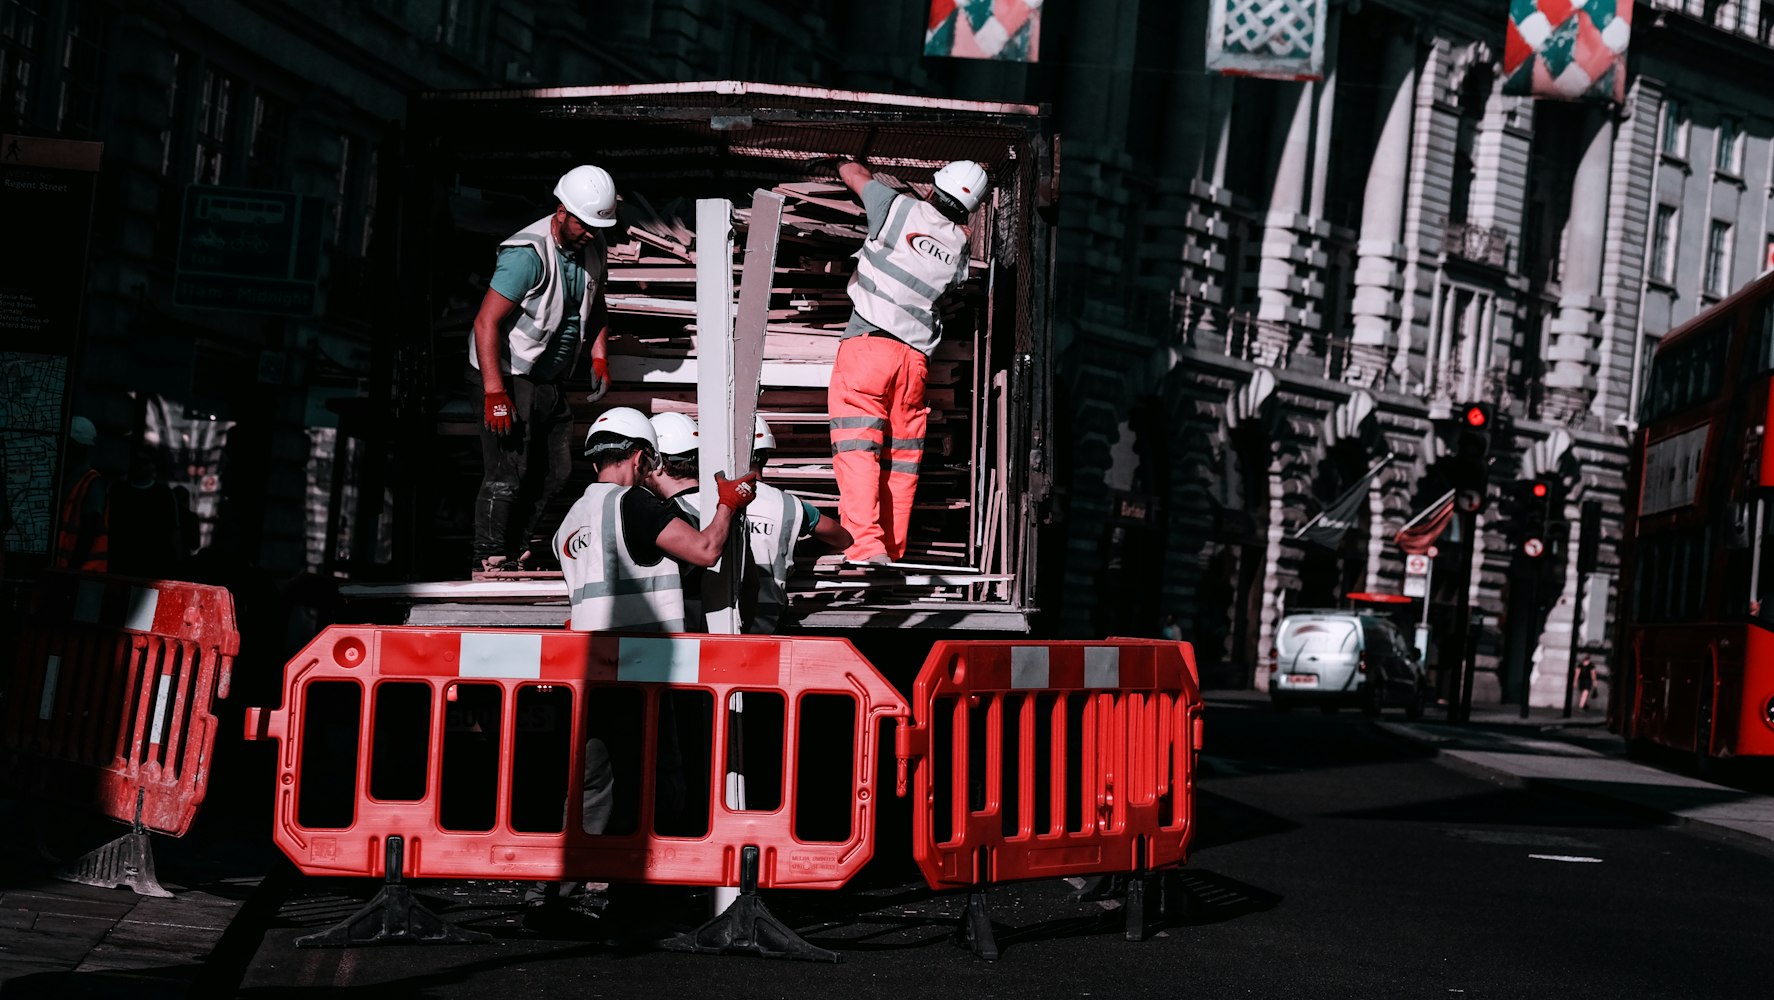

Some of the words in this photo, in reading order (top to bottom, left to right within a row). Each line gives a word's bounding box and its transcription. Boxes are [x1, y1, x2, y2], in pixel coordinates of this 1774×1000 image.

[4, 178, 36, 190] Regent
[39, 181, 68, 193] Street
[191, 252, 222, 266] taxi
[918, 238, 955, 266] CIKU
[236, 287, 310, 307] Midnight
